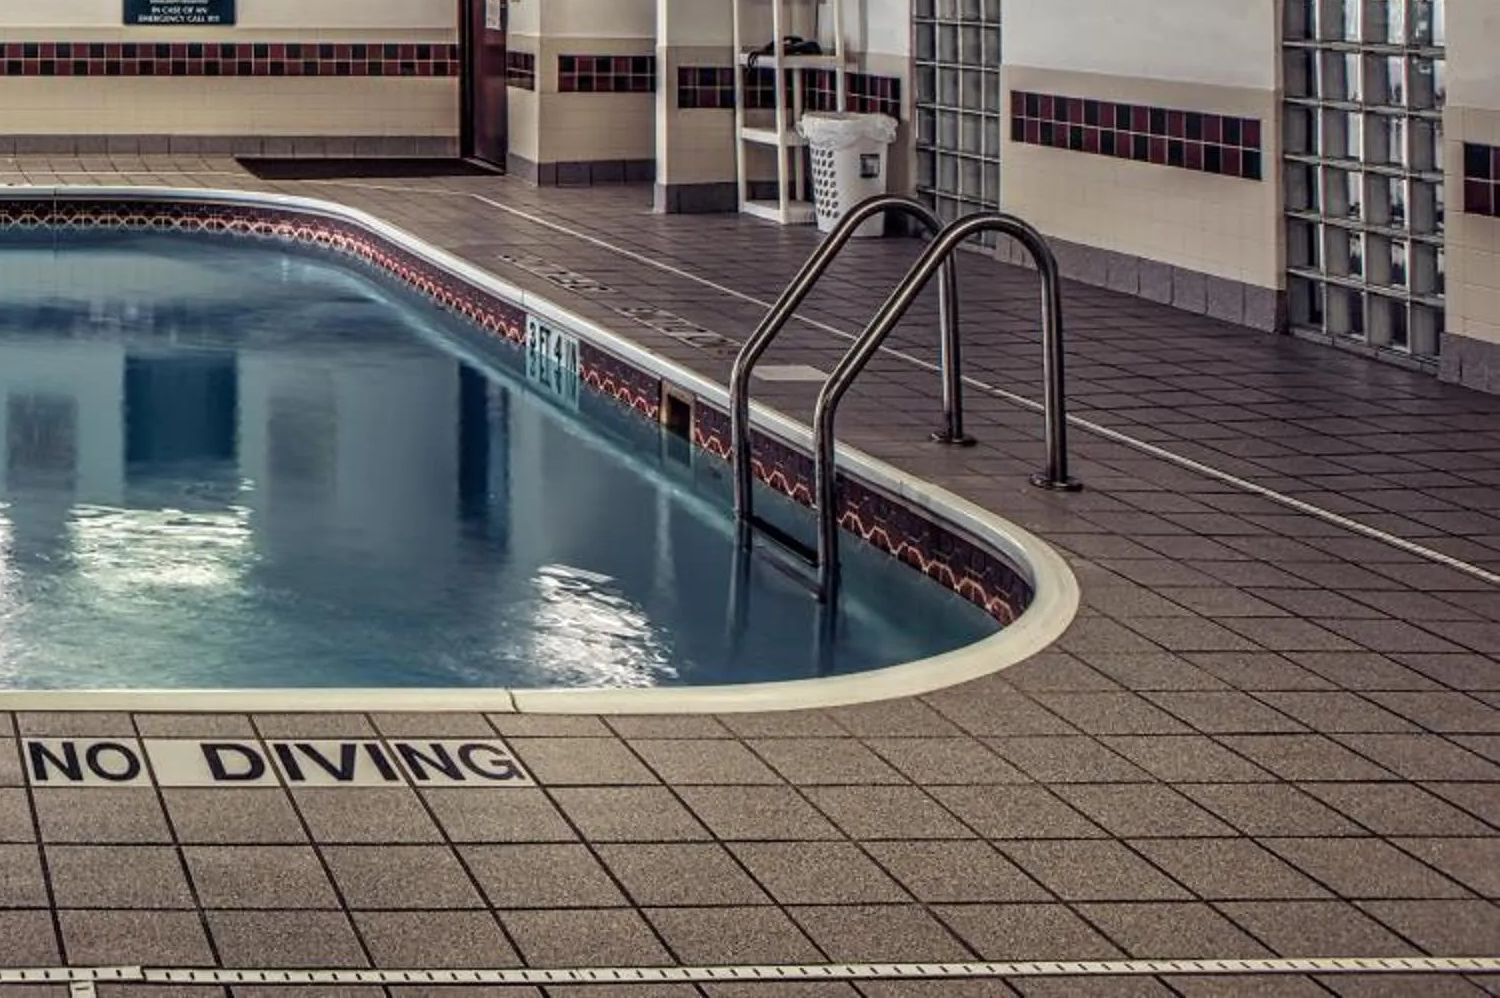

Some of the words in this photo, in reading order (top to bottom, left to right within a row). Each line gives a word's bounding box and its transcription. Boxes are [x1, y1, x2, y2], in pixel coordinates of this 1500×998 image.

[529, 321, 537, 353] 3
[540, 326, 551, 359] FT
[553, 334, 562, 364] 4
[566, 340, 577, 373] IN
[26, 741, 142, 782] NO
[200, 742, 526, 782] DIVING
